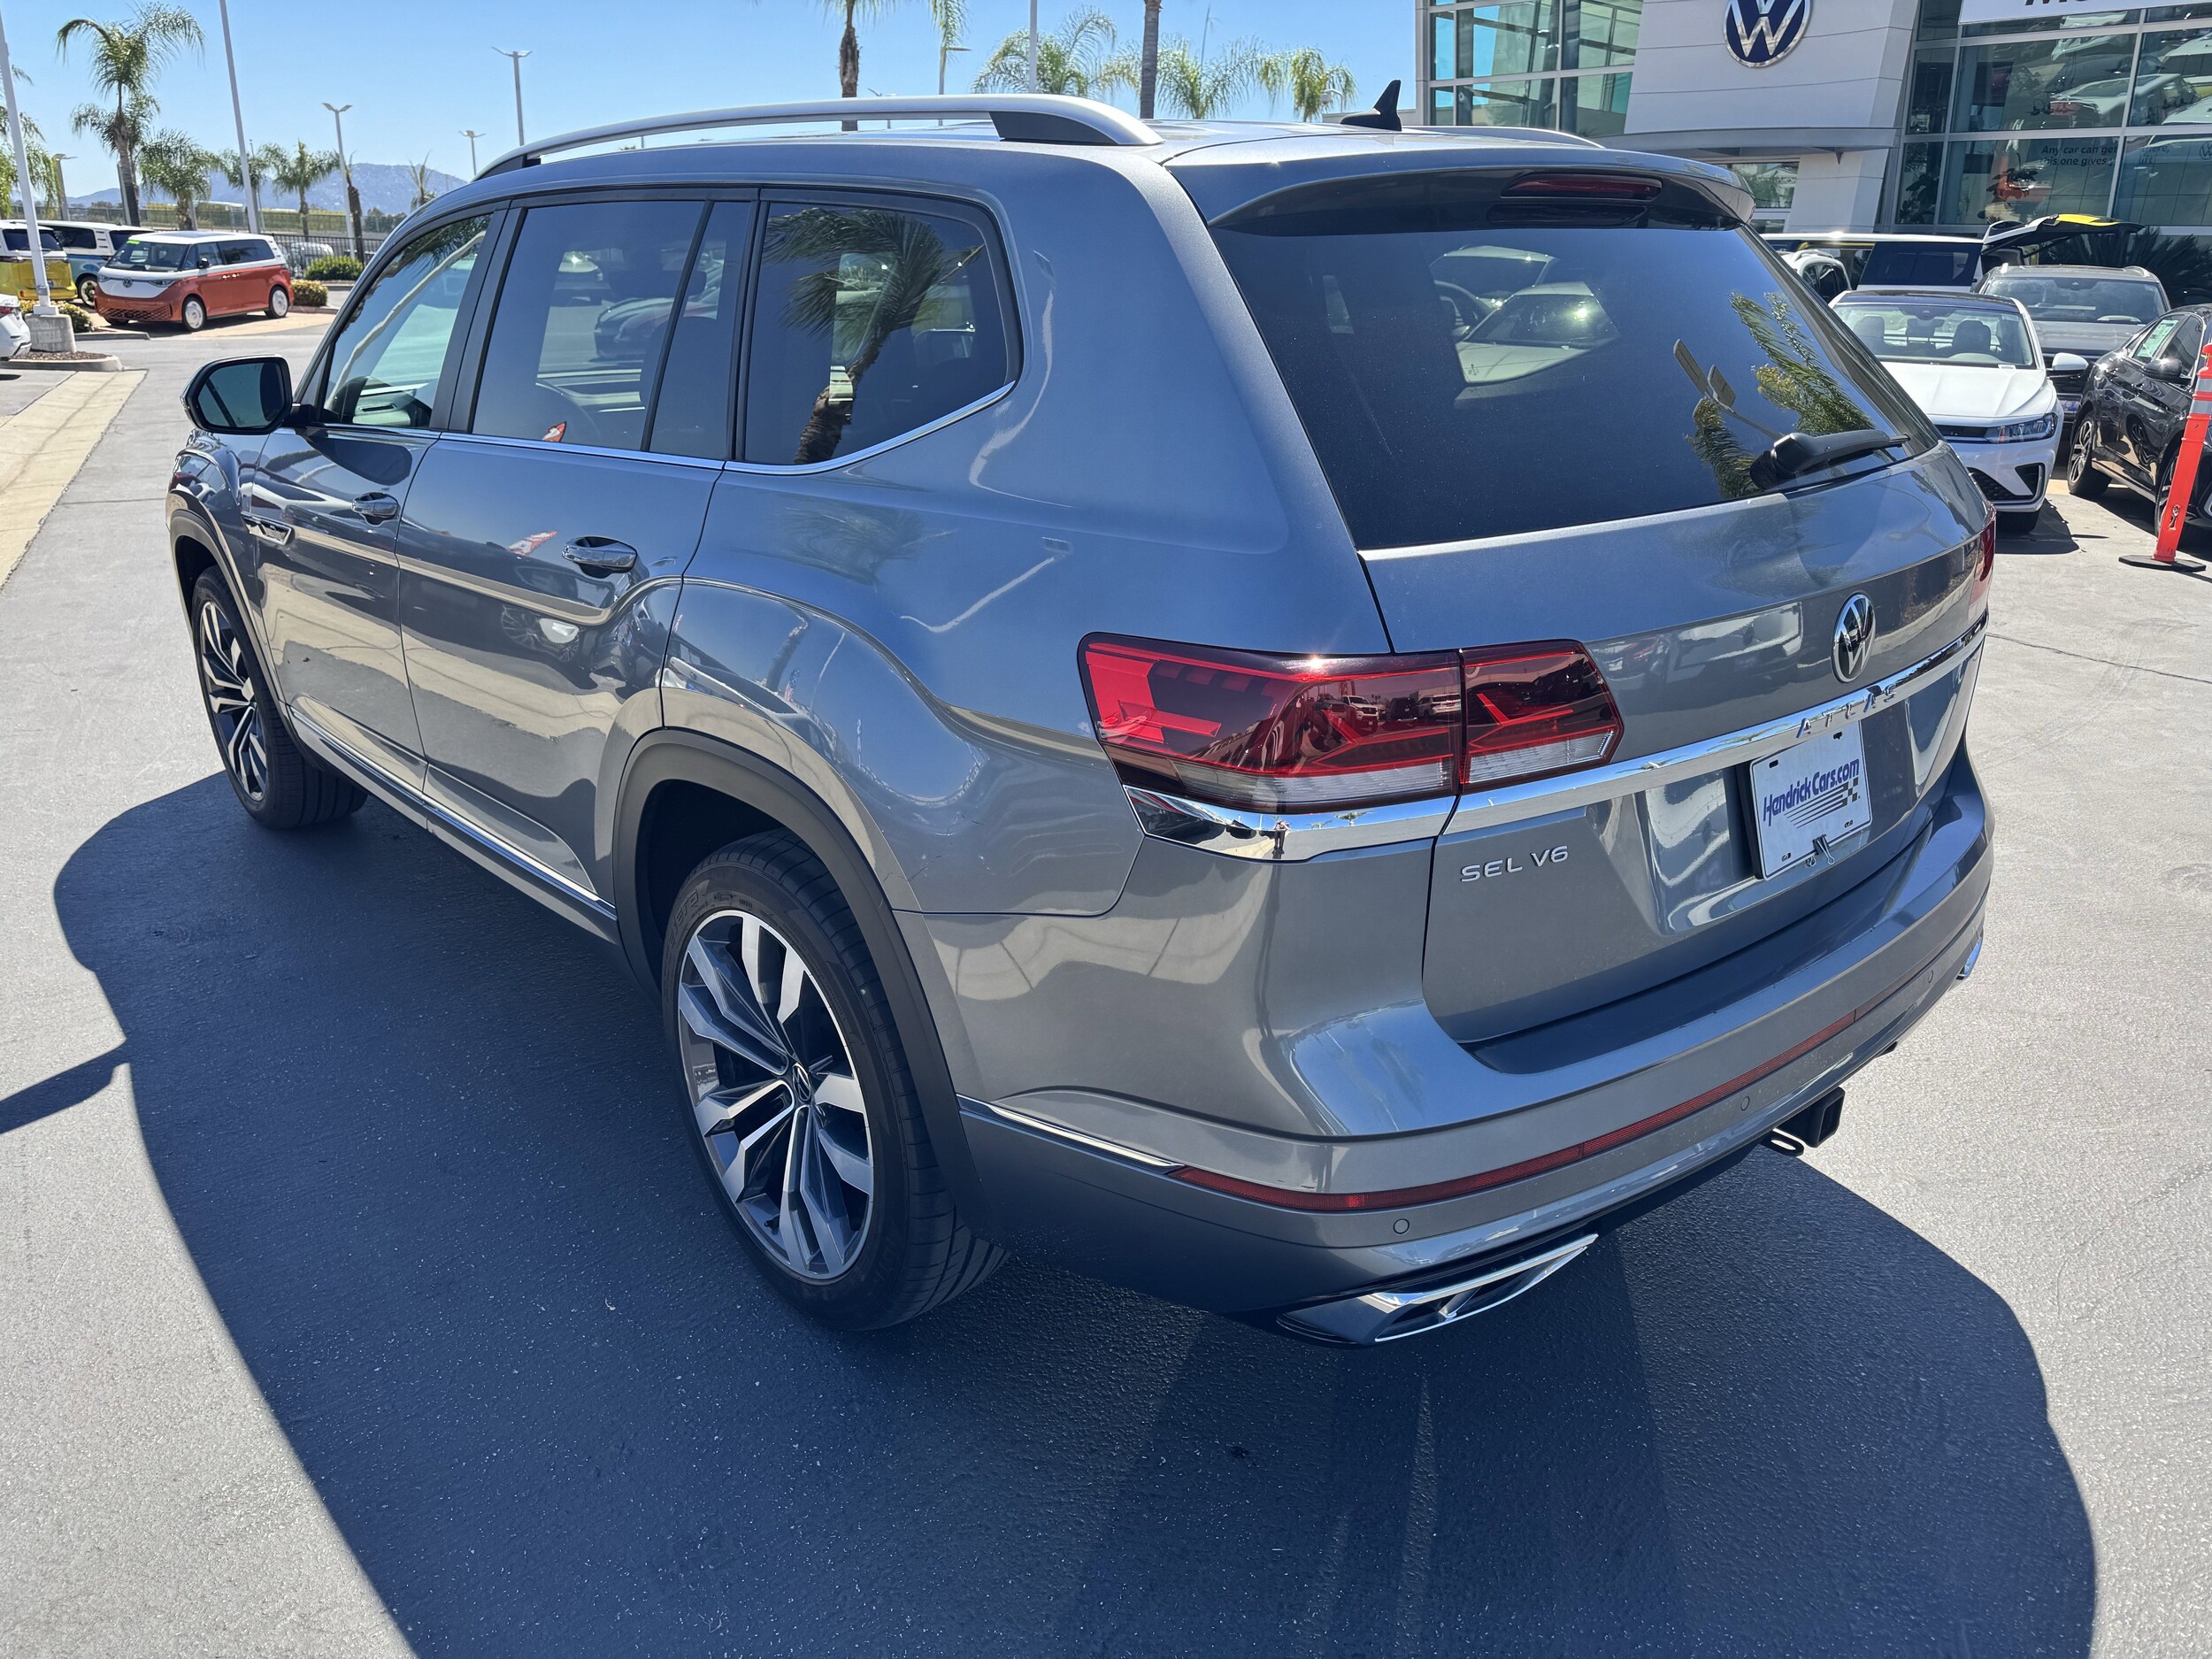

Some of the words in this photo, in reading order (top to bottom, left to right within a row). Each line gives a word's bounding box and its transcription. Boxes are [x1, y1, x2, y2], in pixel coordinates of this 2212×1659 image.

[1724, 0, 1811, 68] W
[2041, 145, 2061, 156] Any
[2081, 157, 2107, 166] gives
[1795, 684, 1897, 738] ATLAS
[1461, 857, 1523, 882] SEL
[1530, 845, 1569, 867] V6
